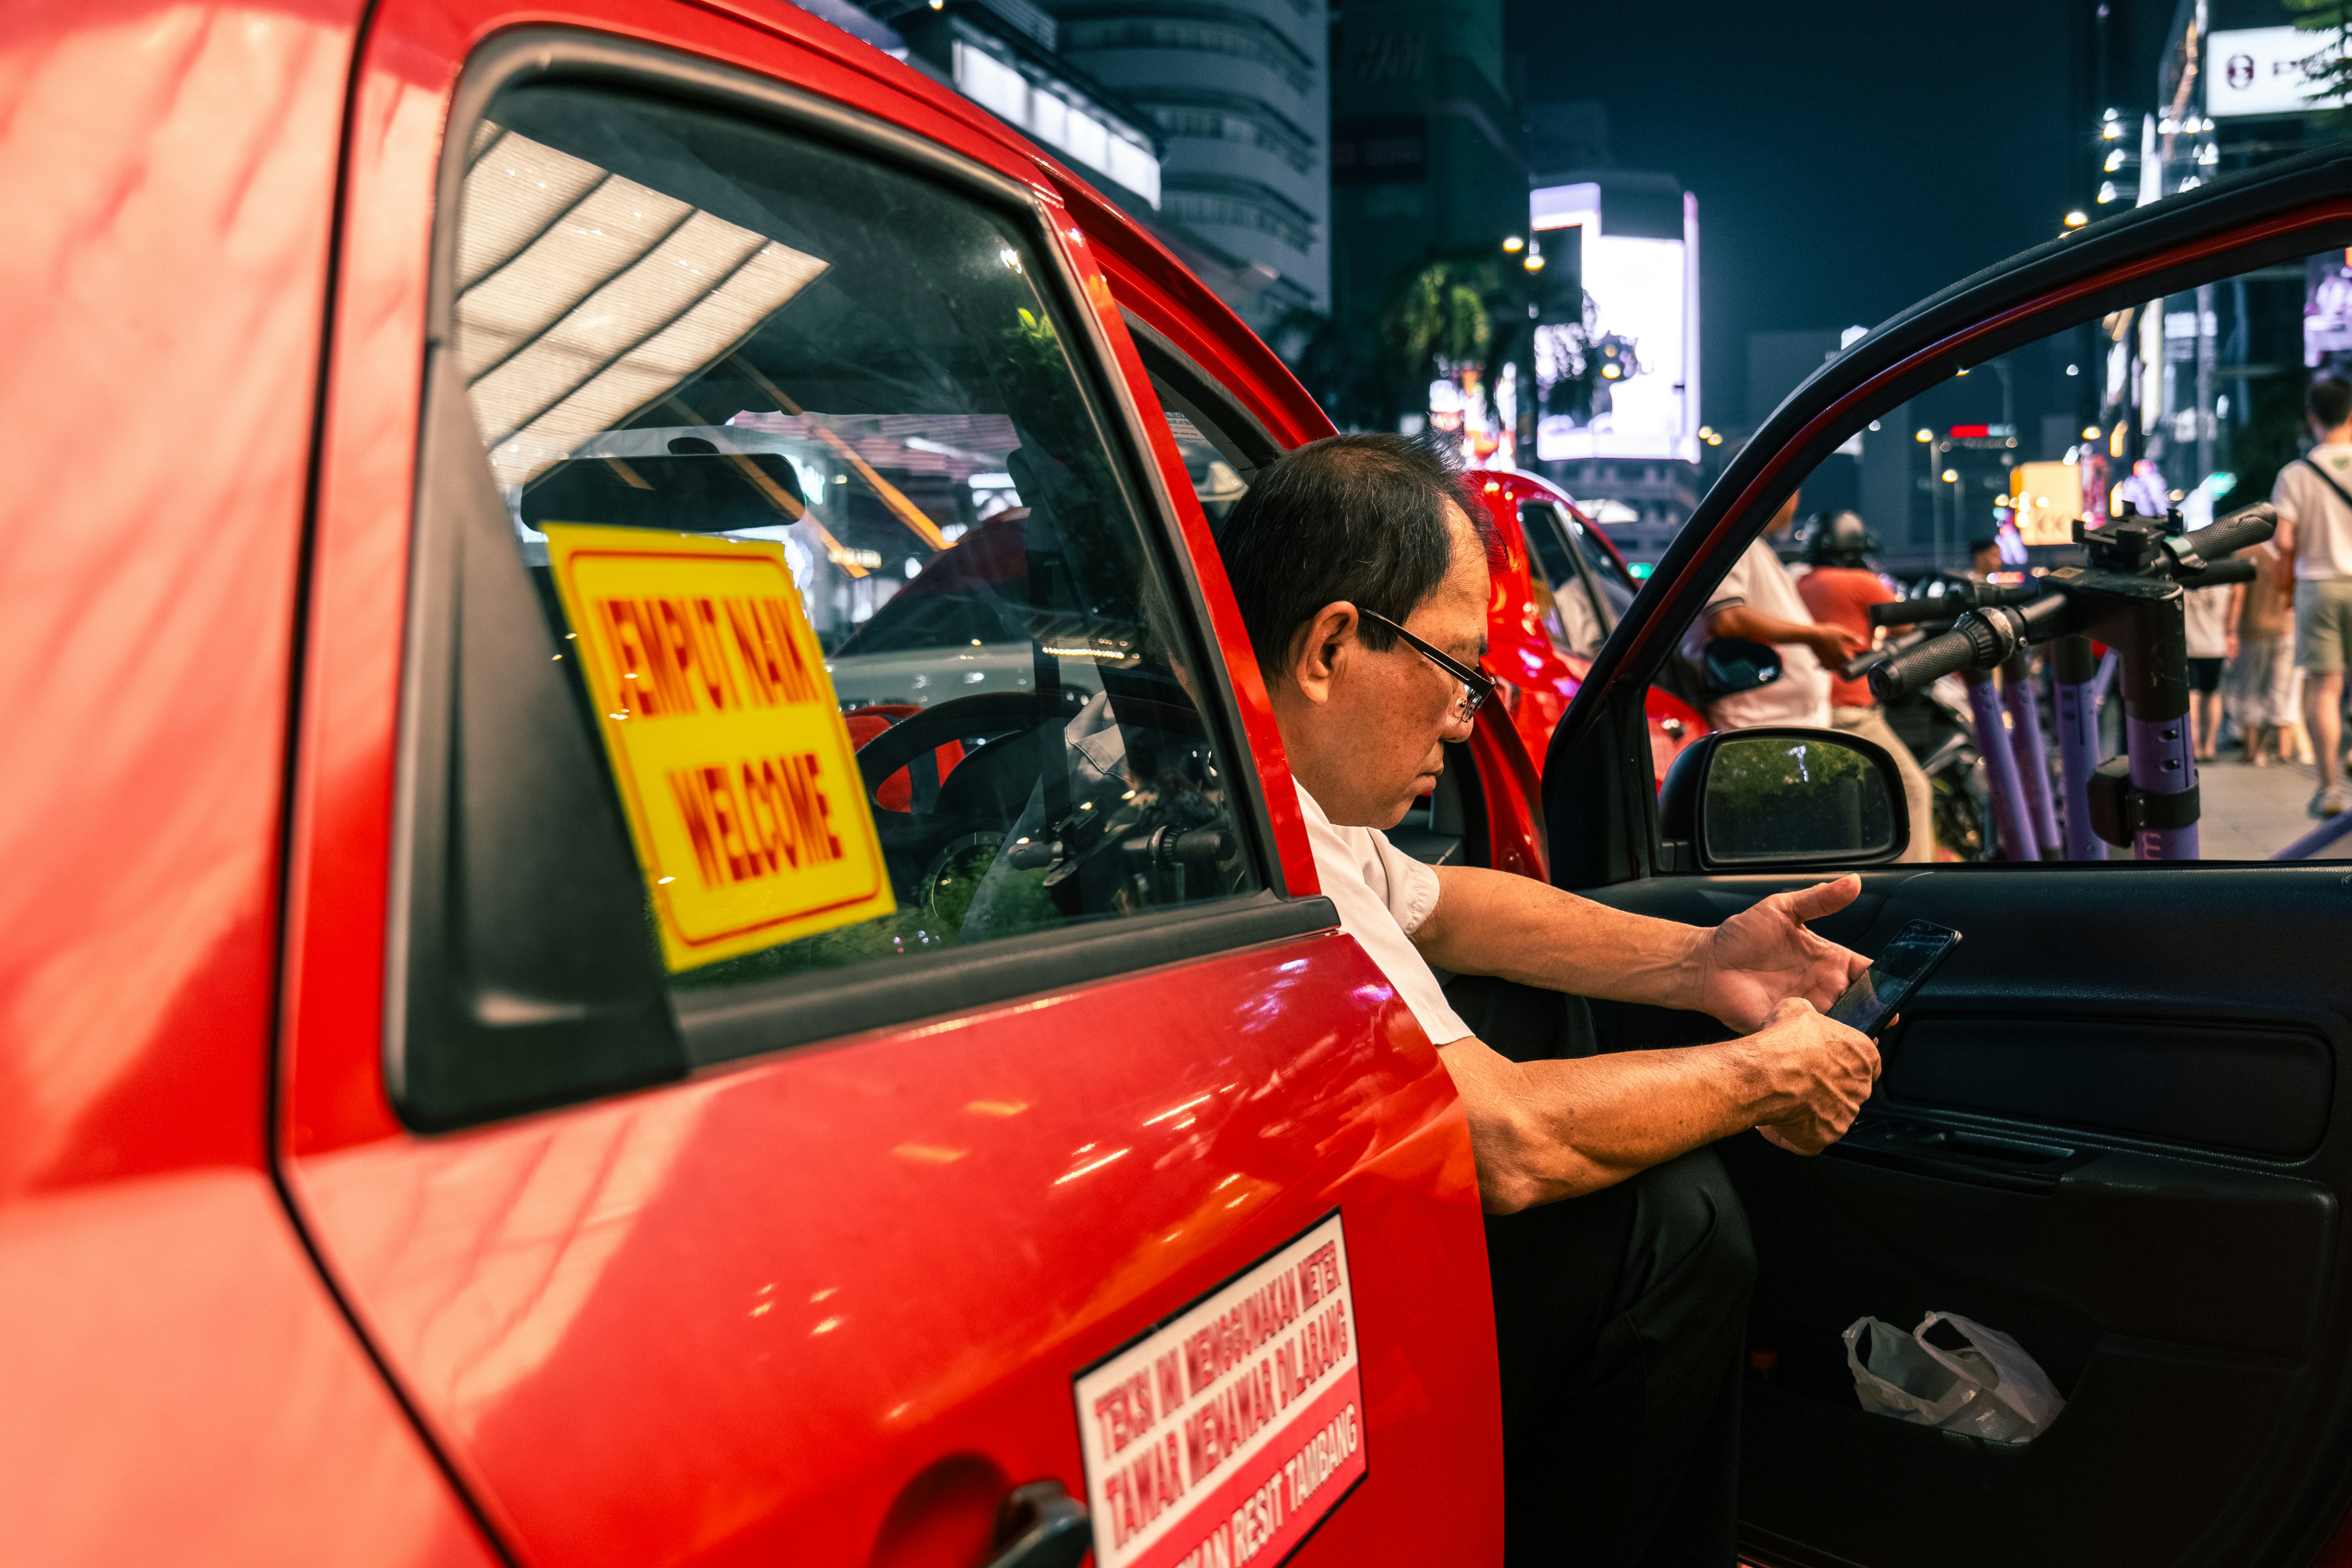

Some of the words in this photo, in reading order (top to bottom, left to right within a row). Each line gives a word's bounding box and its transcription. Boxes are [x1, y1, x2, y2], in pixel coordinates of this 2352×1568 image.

[722, 597, 821, 709] NAIK
[666, 752, 845, 889] WELCOME
[1094, 1366, 1158, 1460] TEKSI
[1155, 1346, 1185, 1419] INI
[1183, 1267, 1299, 1398] MENGGUNAKAN
[1298, 1240, 1341, 1312] METER
[1104, 1431, 1185, 1550] TAWAR
[1184, 1358, 1277, 1487] MENAWAR
[1275, 1298, 1348, 1410] DILARANG
[1232, 1469, 1283, 1568] RESIT
[1285, 1401, 1357, 1513] TAMBANG
